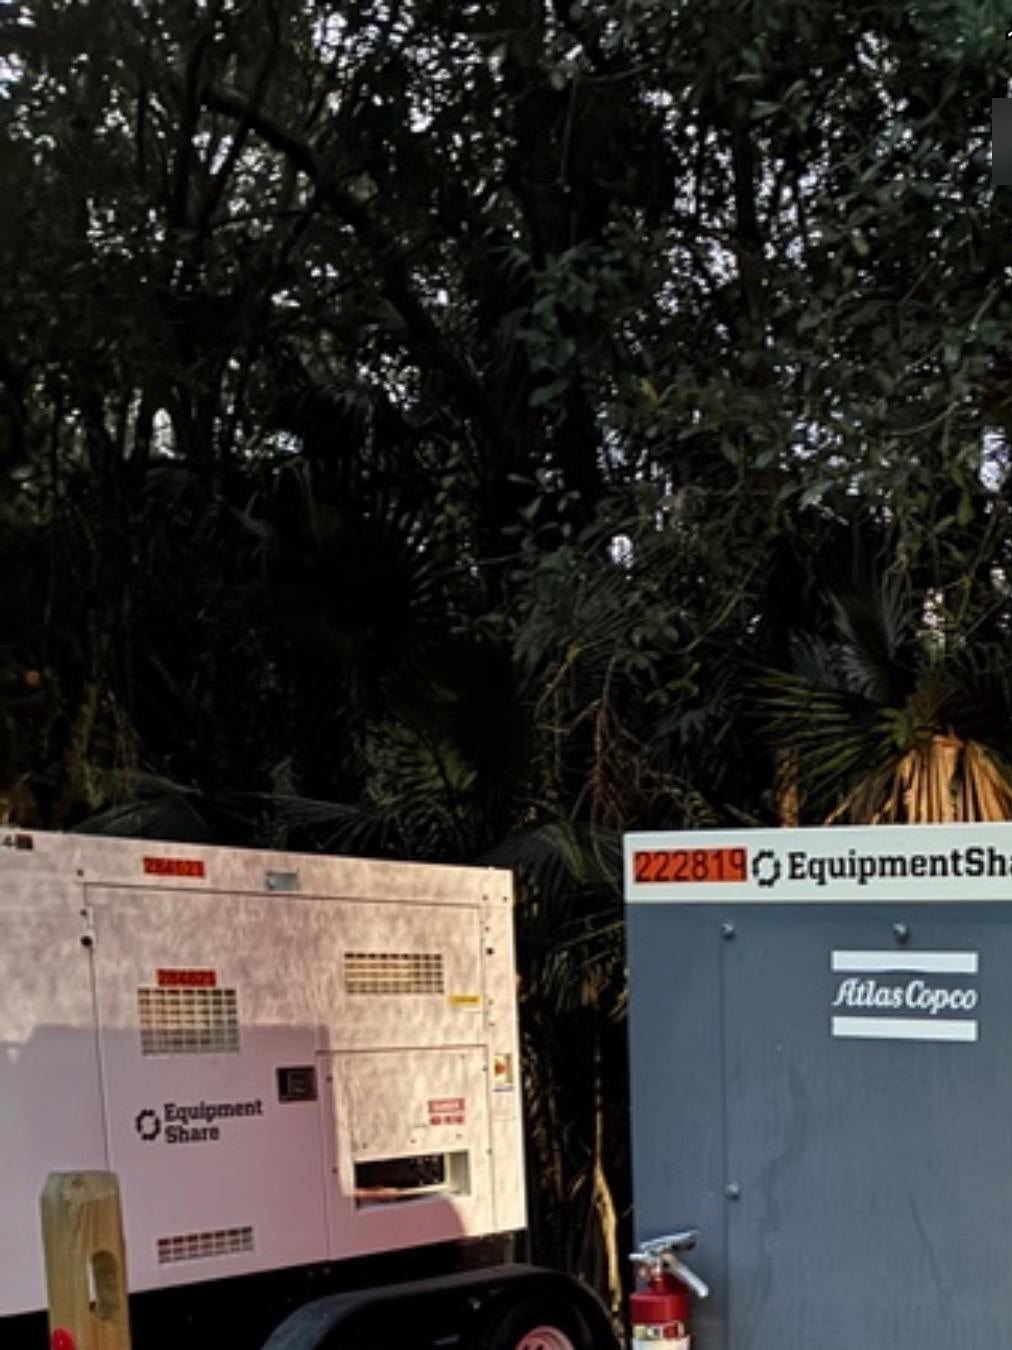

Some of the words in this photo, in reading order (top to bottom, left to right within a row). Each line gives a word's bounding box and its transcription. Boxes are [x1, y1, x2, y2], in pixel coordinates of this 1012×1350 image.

[634, 848, 747, 883] 222819
[164, 1100, 263, 1125] Equipment
[165, 1124, 220, 1143] Share
